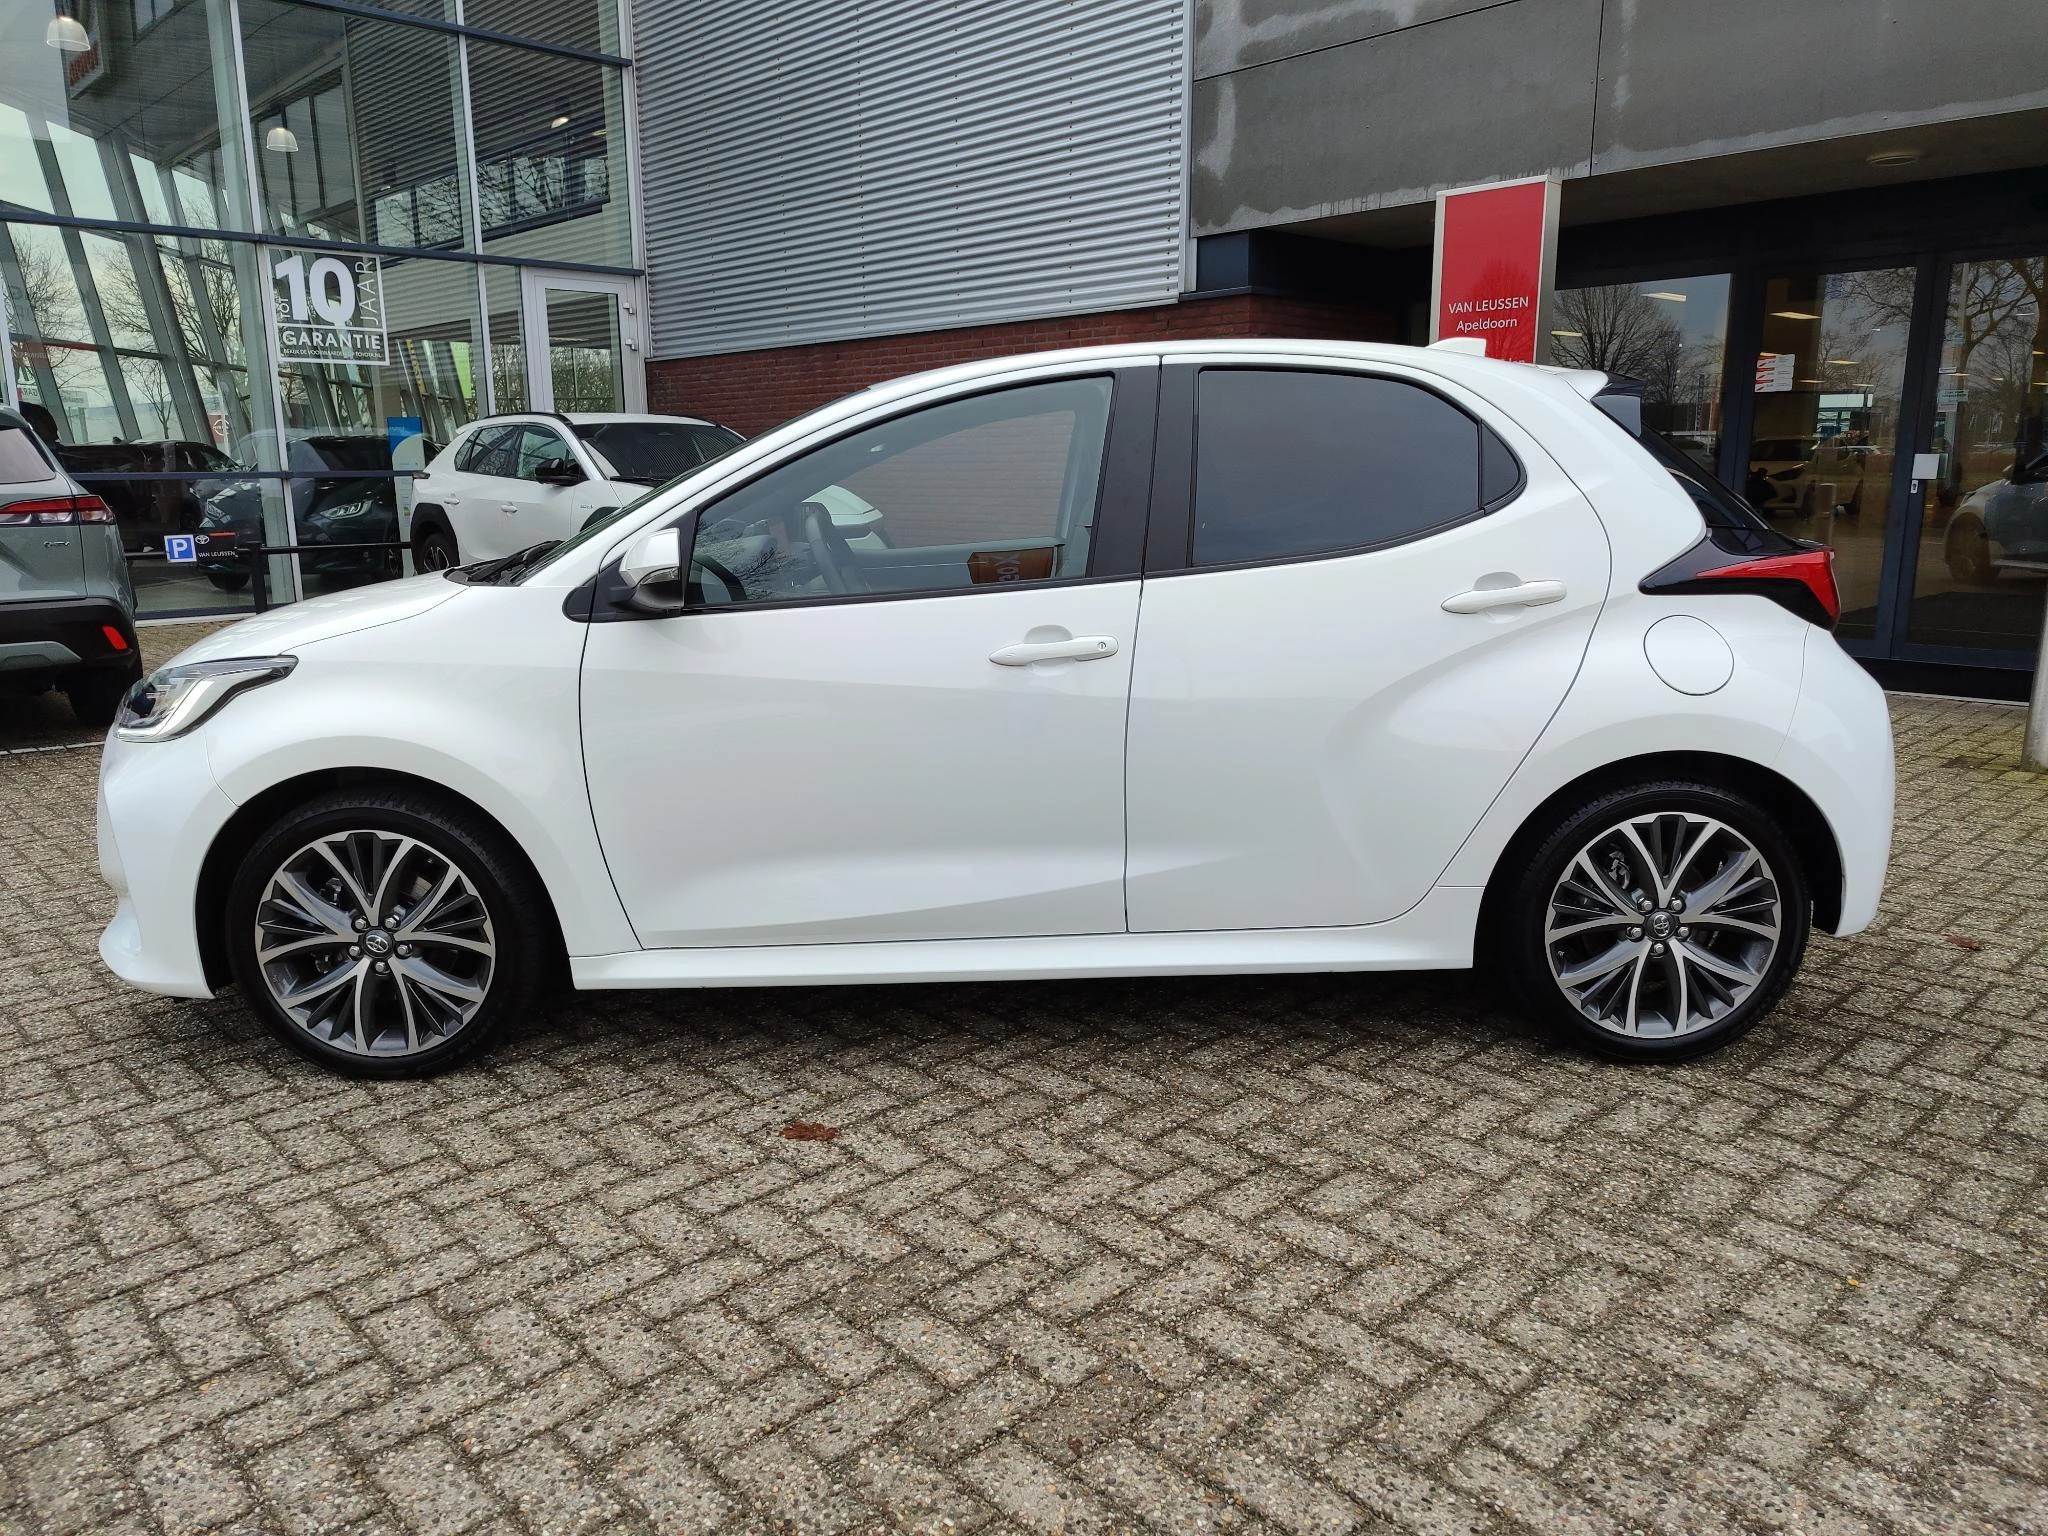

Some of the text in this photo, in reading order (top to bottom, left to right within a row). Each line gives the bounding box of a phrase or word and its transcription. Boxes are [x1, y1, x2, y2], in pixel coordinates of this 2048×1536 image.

[275, 255, 356, 325] 10
[355, 260, 379, 326] JAAR
[279, 297, 291, 319] TOT
[1449, 296, 1529, 314] VAN LEUSSEN
[1456, 318, 1518, 333] Apeldoorn
[282, 330, 381, 350] GARANTIE
[172, 539, 188, 558] P
